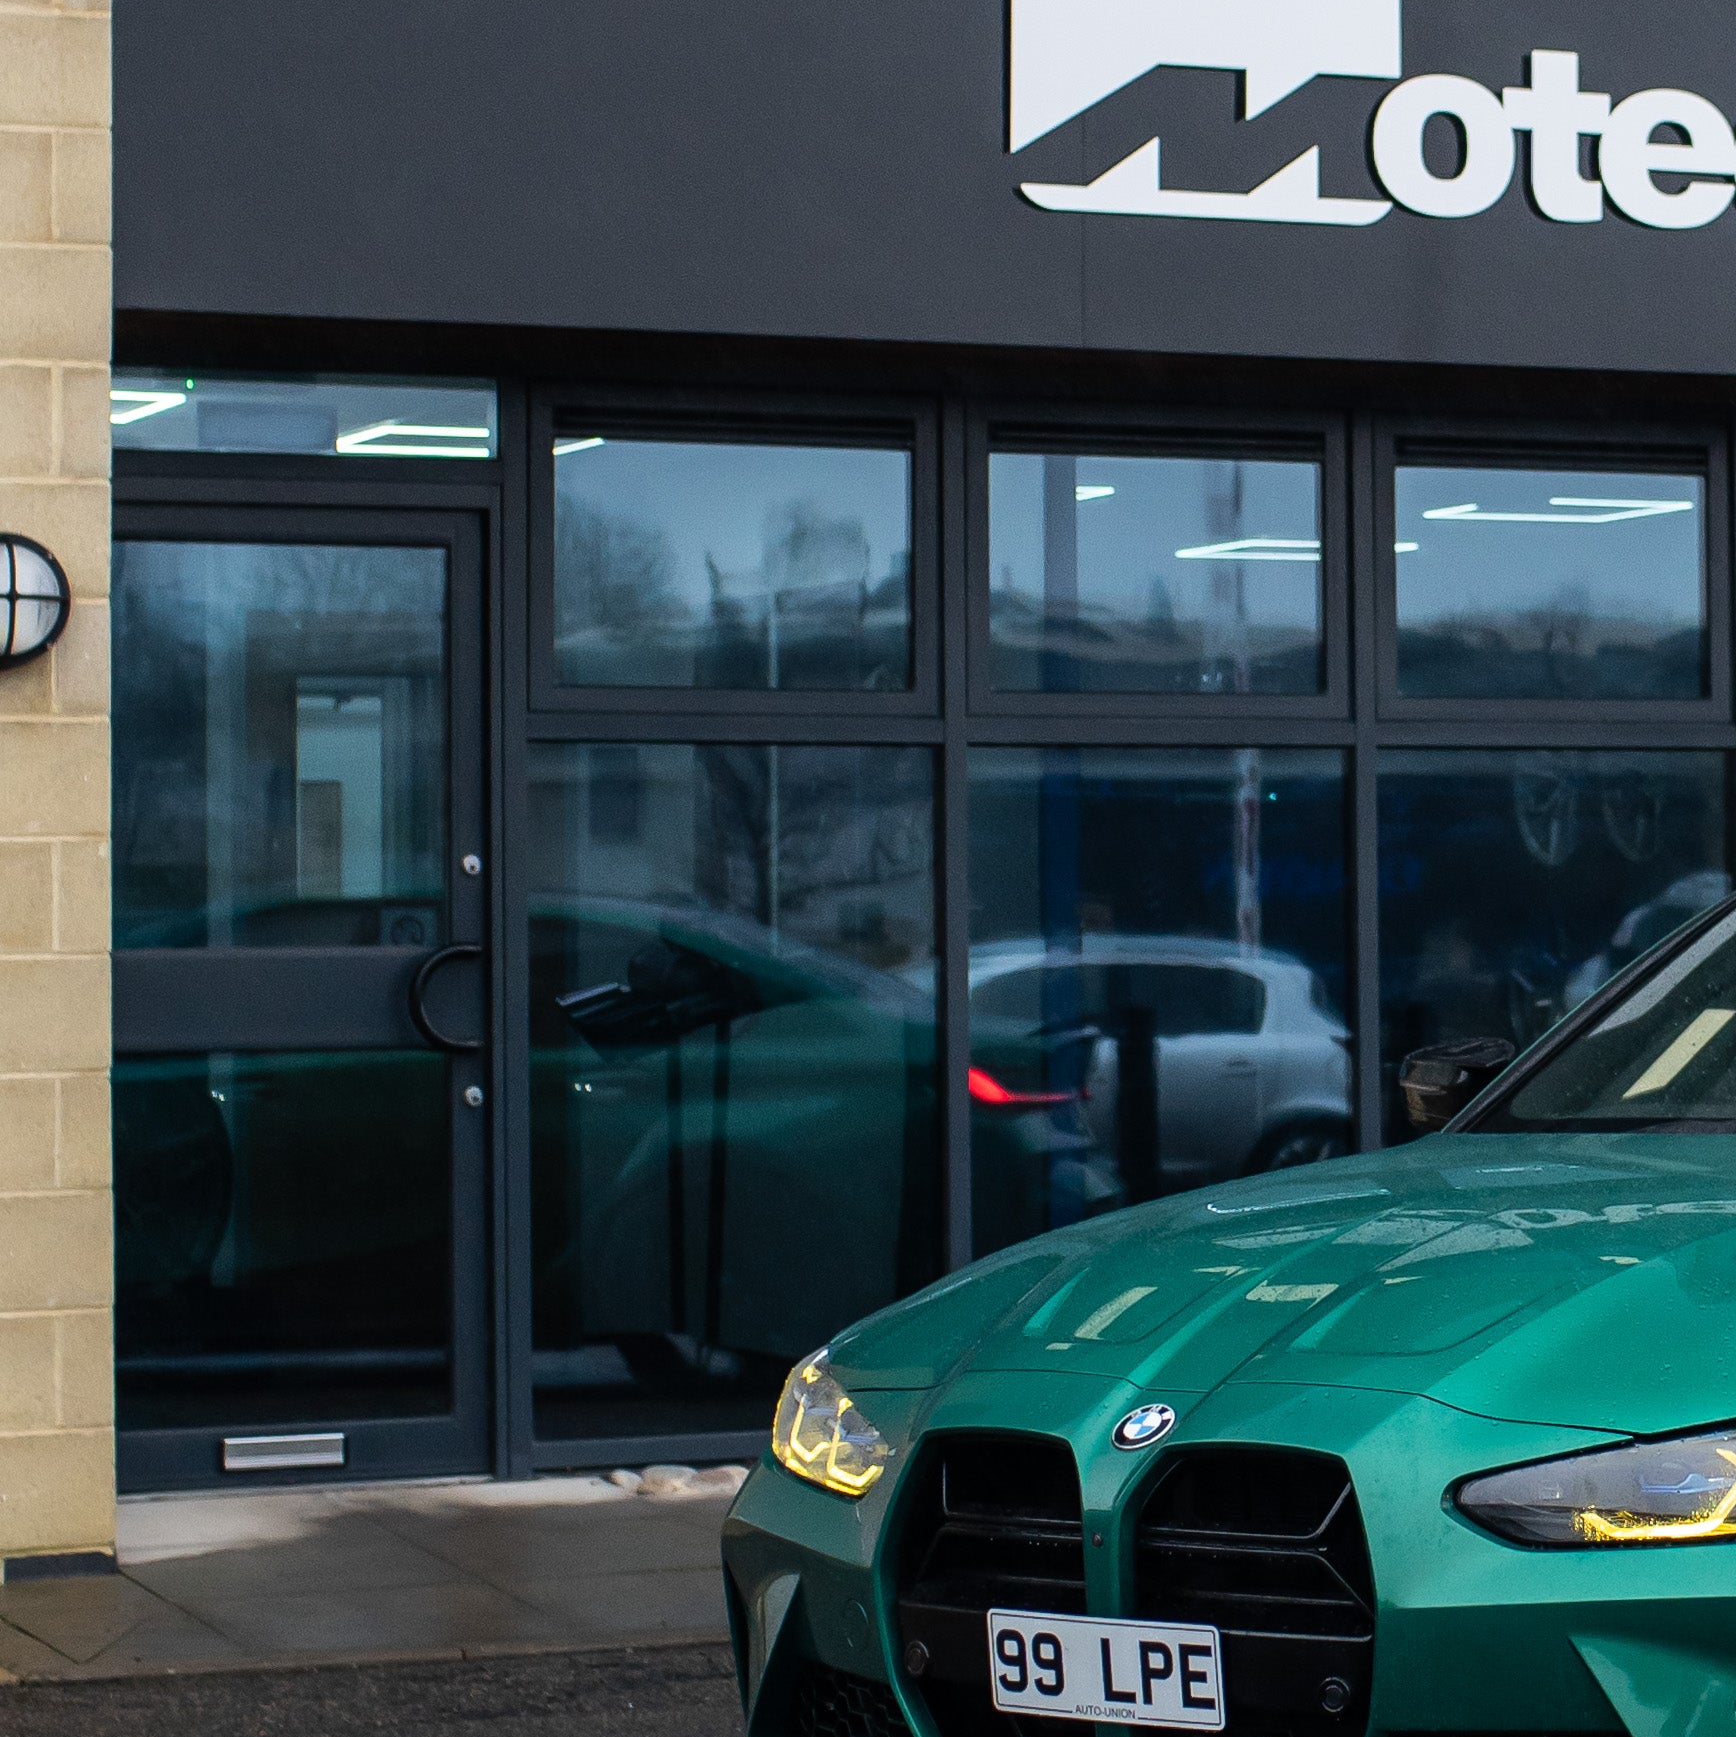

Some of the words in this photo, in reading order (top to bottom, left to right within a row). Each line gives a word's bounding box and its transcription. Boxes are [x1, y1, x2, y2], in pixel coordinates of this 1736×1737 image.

[996, 1628, 1066, 1697] 99
[1100, 1637, 1217, 1710] LPE
[1075, 1704, 1136, 1720] AUTO-UNION
